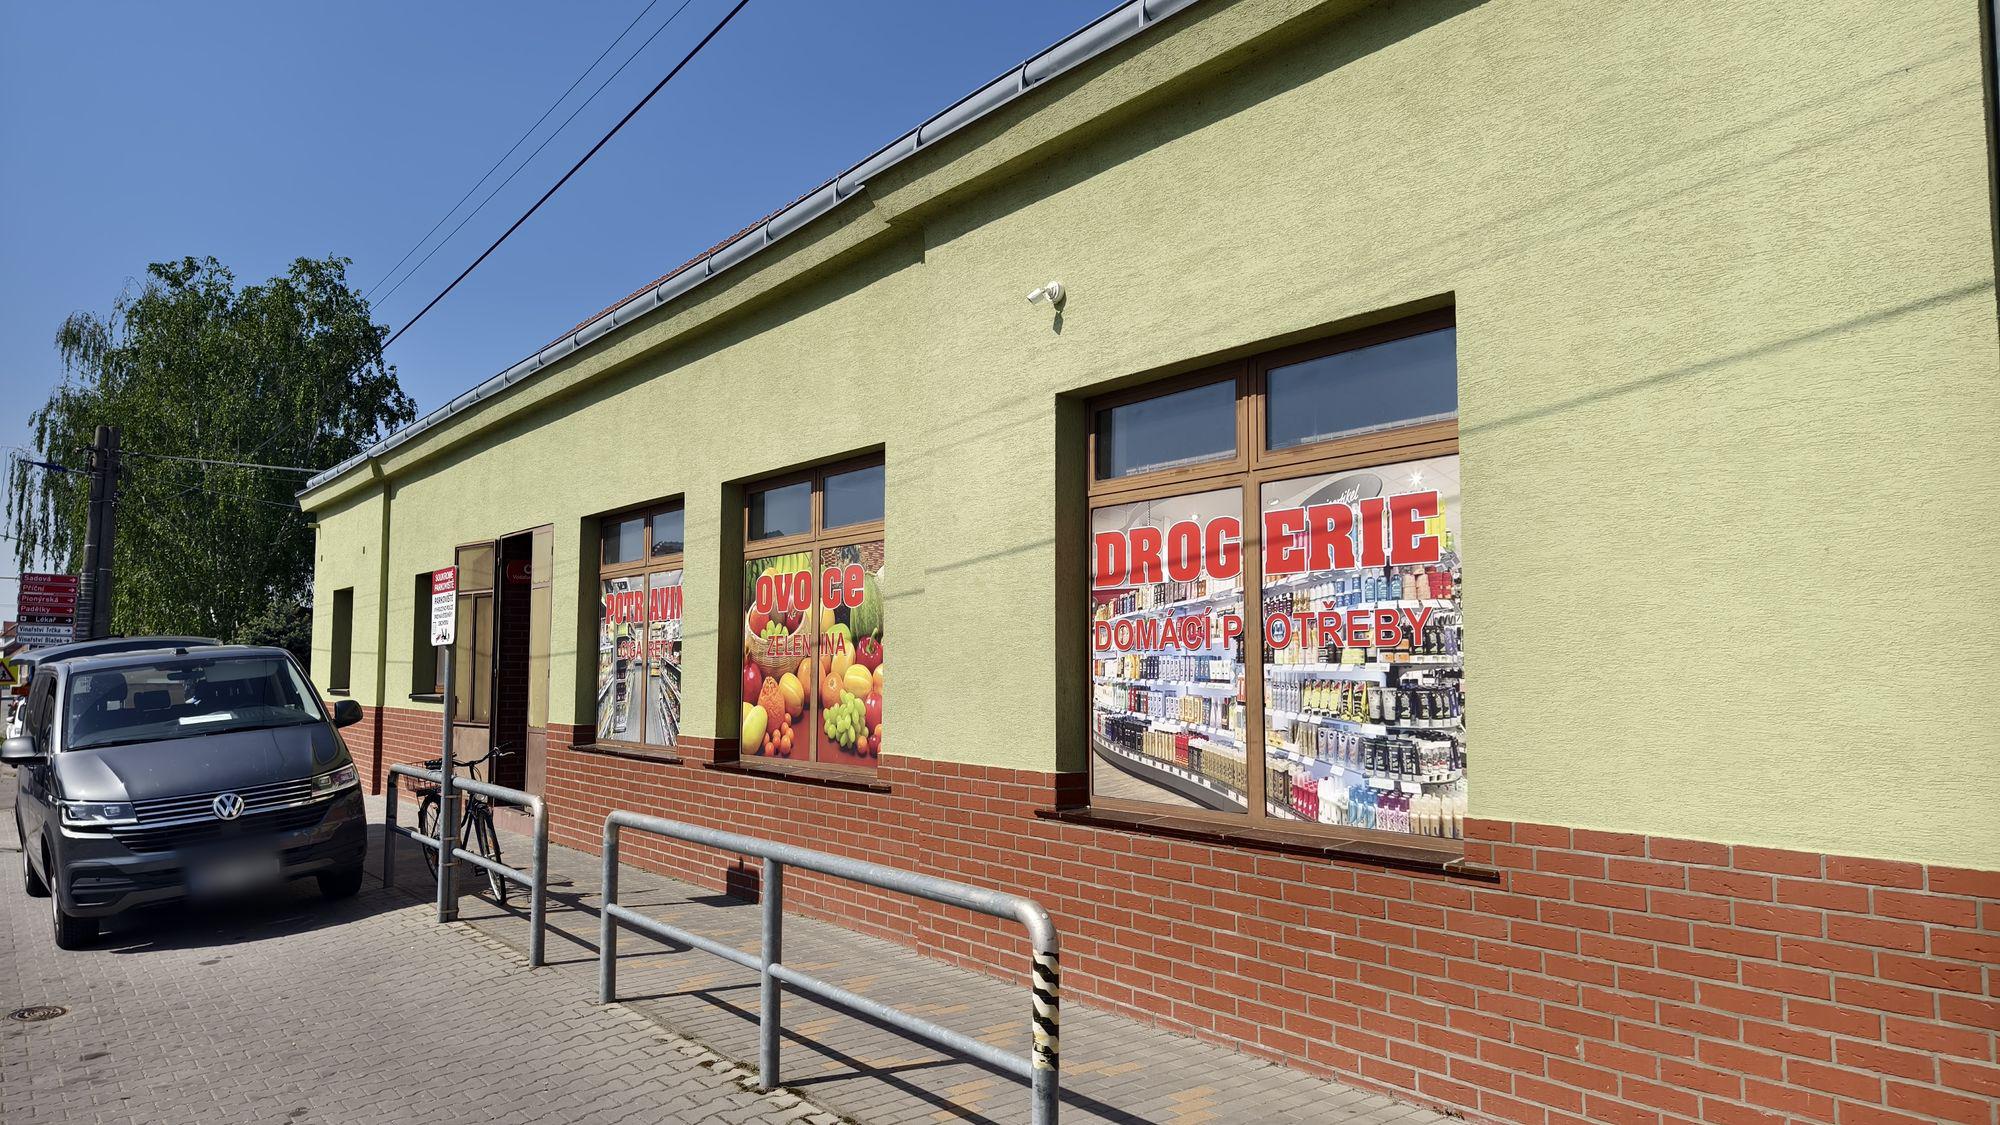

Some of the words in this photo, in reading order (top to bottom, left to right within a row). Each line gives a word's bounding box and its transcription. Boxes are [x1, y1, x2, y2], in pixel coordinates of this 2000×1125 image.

[1094, 489, 1441, 588] DROGERIE
[24, 574, 51, 582] Sadová
[22, 584, 45, 592] Příční
[21, 595, 59, 604] Pionýrská
[20, 605, 51, 614] Padělky
[19, 625, 44, 633] Vinařství
[1094, 606, 1212, 652] DOMÁCÍ
[1223, 601, 1434, 651] POTŘEBY
[18, 635, 43, 643] Vinařství
[767, 632, 847, 657] ZELENINA
